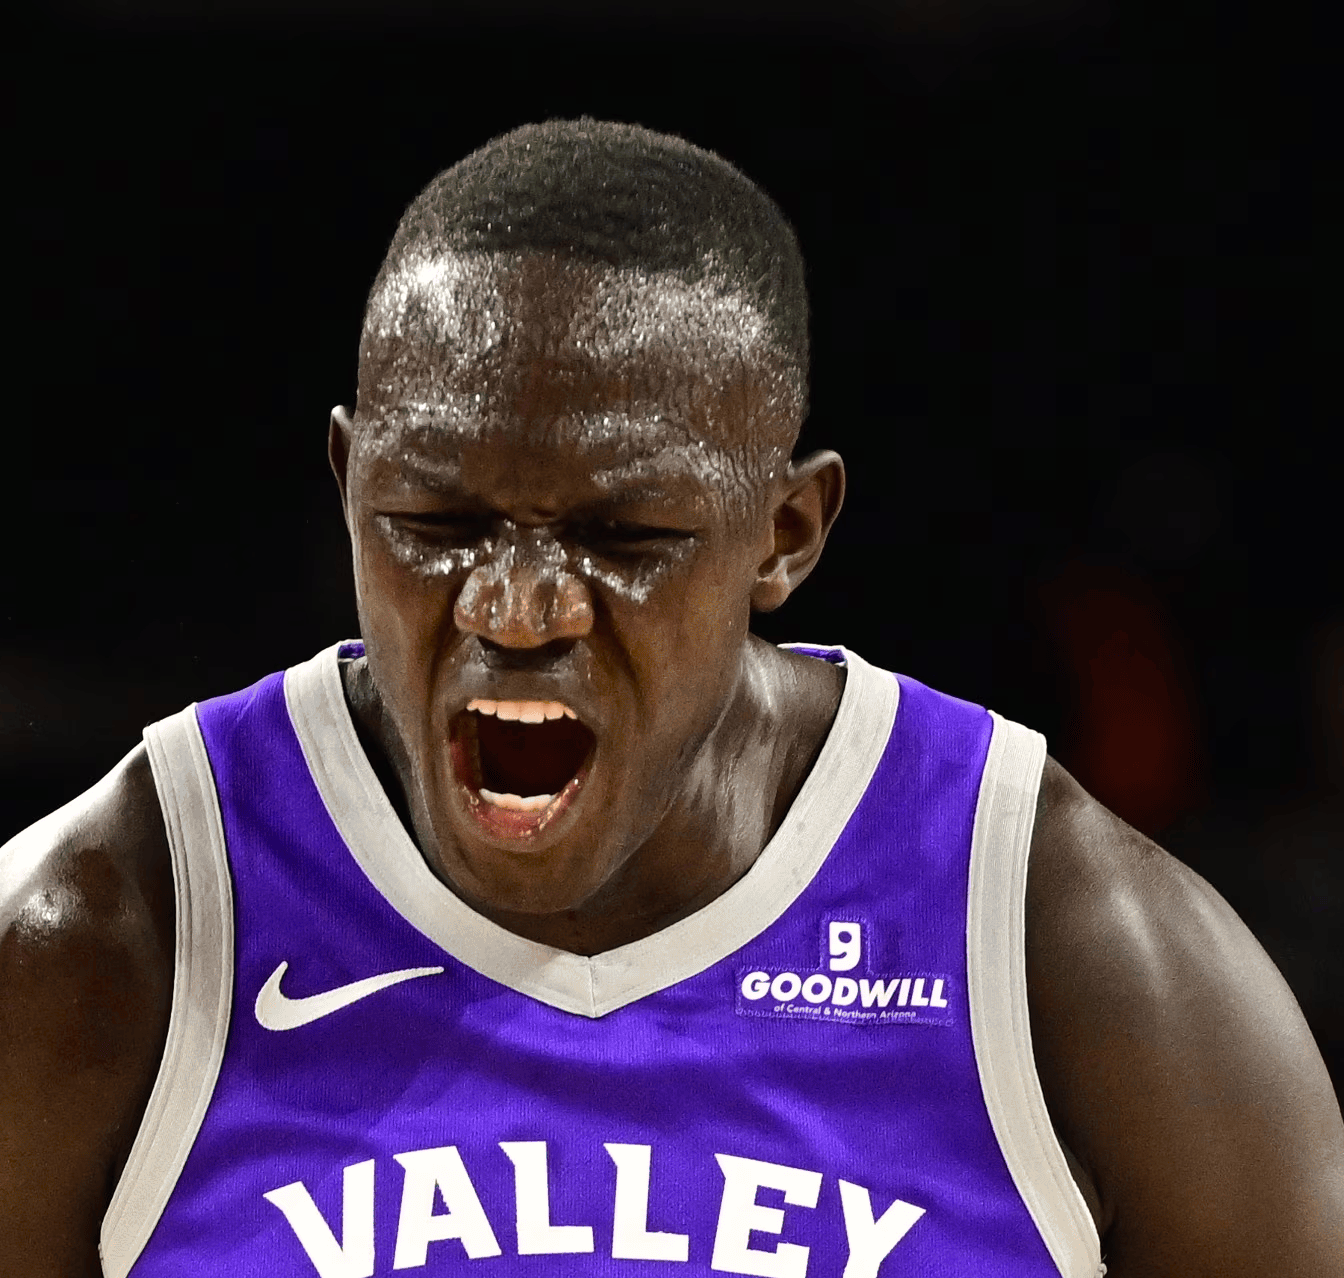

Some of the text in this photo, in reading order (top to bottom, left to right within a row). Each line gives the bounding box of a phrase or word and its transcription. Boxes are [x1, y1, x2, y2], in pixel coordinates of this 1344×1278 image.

[741, 971, 949, 1008] GOODWILL
[773, 1003, 917, 1020] of Central & Northern Arizona
